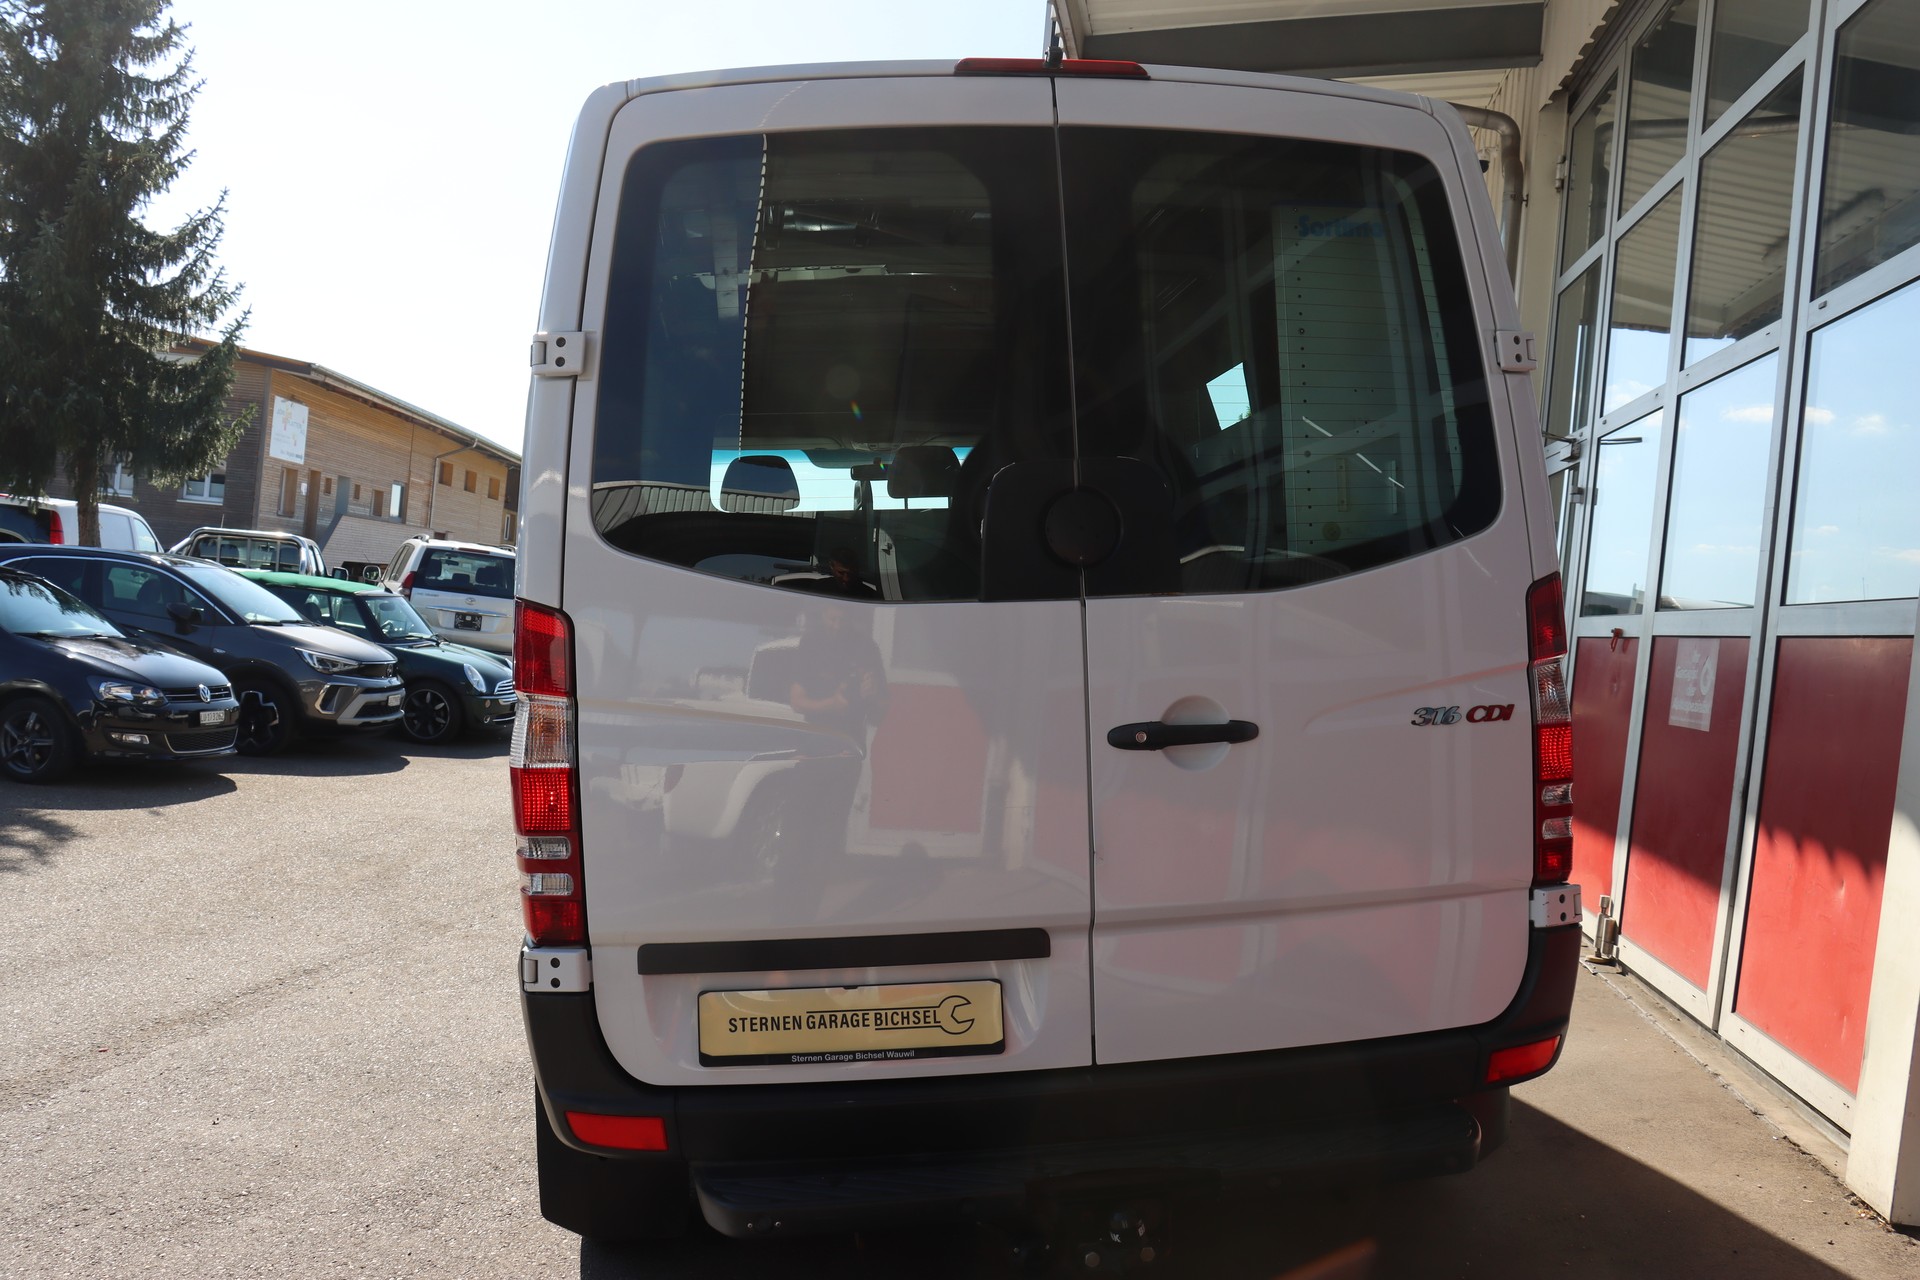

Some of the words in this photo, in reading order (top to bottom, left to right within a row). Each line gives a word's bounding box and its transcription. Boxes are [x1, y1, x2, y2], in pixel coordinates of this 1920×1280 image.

[1411, 706, 1462, 726] 316
[1466, 704, 1515, 723] CDI
[728, 1015, 803, 1033] STERNEN
[806, 1012, 870, 1030] GARAGE
[874, 1009, 942, 1026] BICHSEL
[791, 1054, 823, 1063] Sternen
[824, 1053, 854, 1063] Garage
[855, 1050, 885, 1060] Bichsel
[886, 1049, 915, 1059] Wauwil
